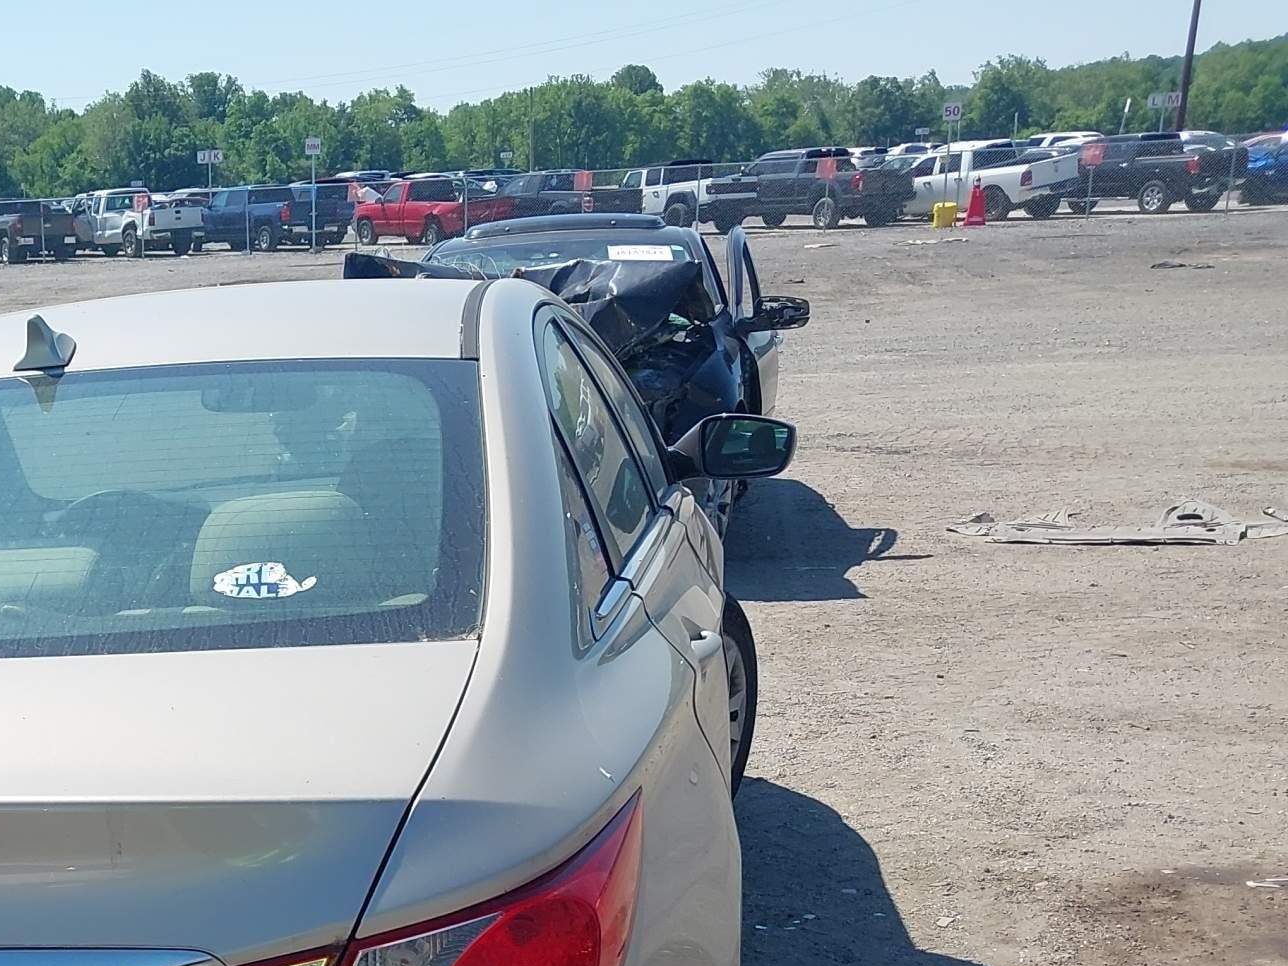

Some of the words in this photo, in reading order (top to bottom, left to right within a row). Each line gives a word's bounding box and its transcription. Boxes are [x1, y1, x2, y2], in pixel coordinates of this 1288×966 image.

[1166, 95, 1181, 105] M
[943, 106, 961, 117] 50
[306, 143, 320, 151] MM
